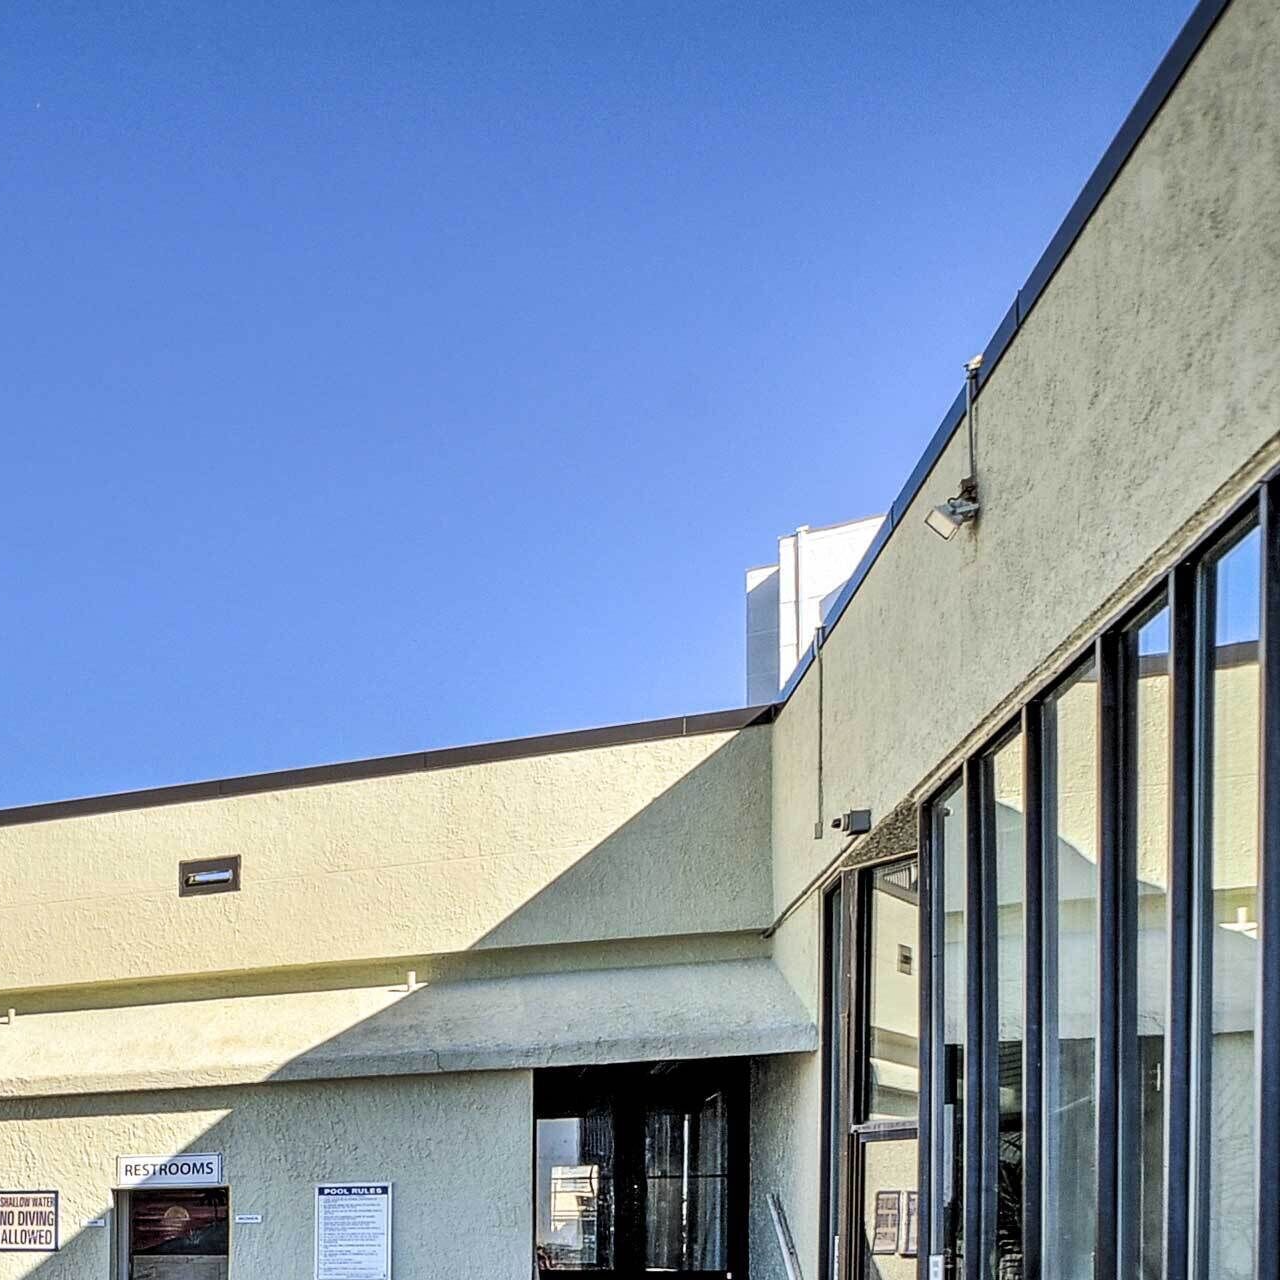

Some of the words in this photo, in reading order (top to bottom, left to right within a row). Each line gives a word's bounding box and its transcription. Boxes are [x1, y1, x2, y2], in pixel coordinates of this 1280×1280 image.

[125, 1161, 214, 1177] RESTROOMS
[0, 1196, 30, 1208] SHALLOW
[31, 1196, 54, 1207] WATER
[0, 1211, 15, 1226] NO
[18, 1210, 54, 1226] DIVING
[1, 1229, 53, 1245] ALLOWED
